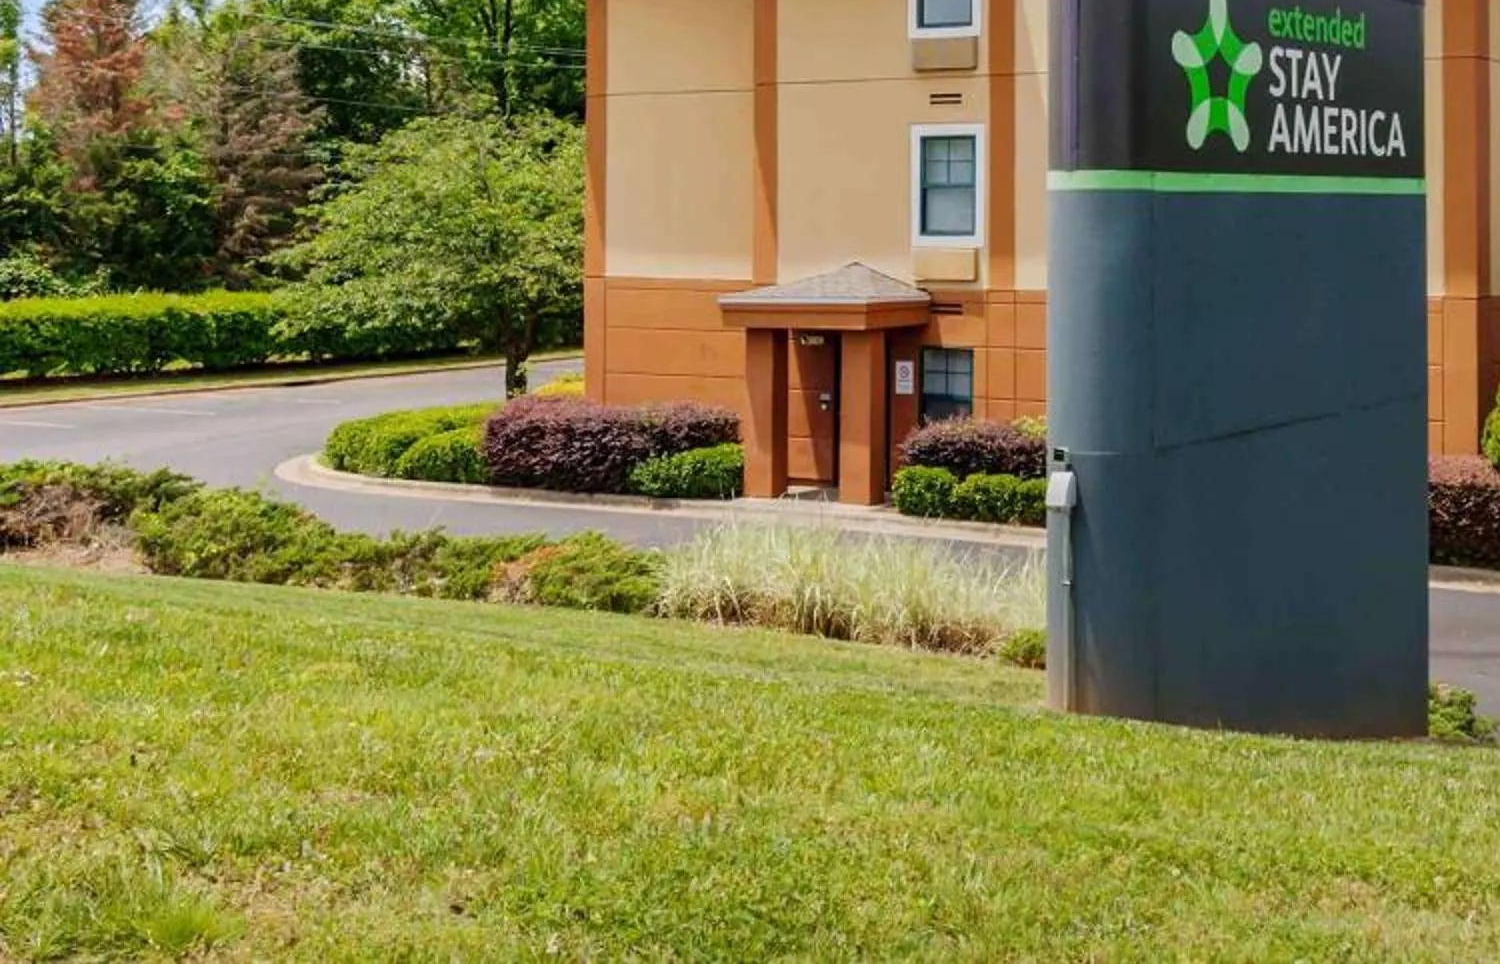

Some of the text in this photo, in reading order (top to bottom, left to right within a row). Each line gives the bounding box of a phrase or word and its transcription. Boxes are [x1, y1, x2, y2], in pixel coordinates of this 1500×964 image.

[1268, 5, 1366, 49] extended
[1269, 46, 1341, 101] STAY
[1268, 103, 1406, 157] AMERICA
